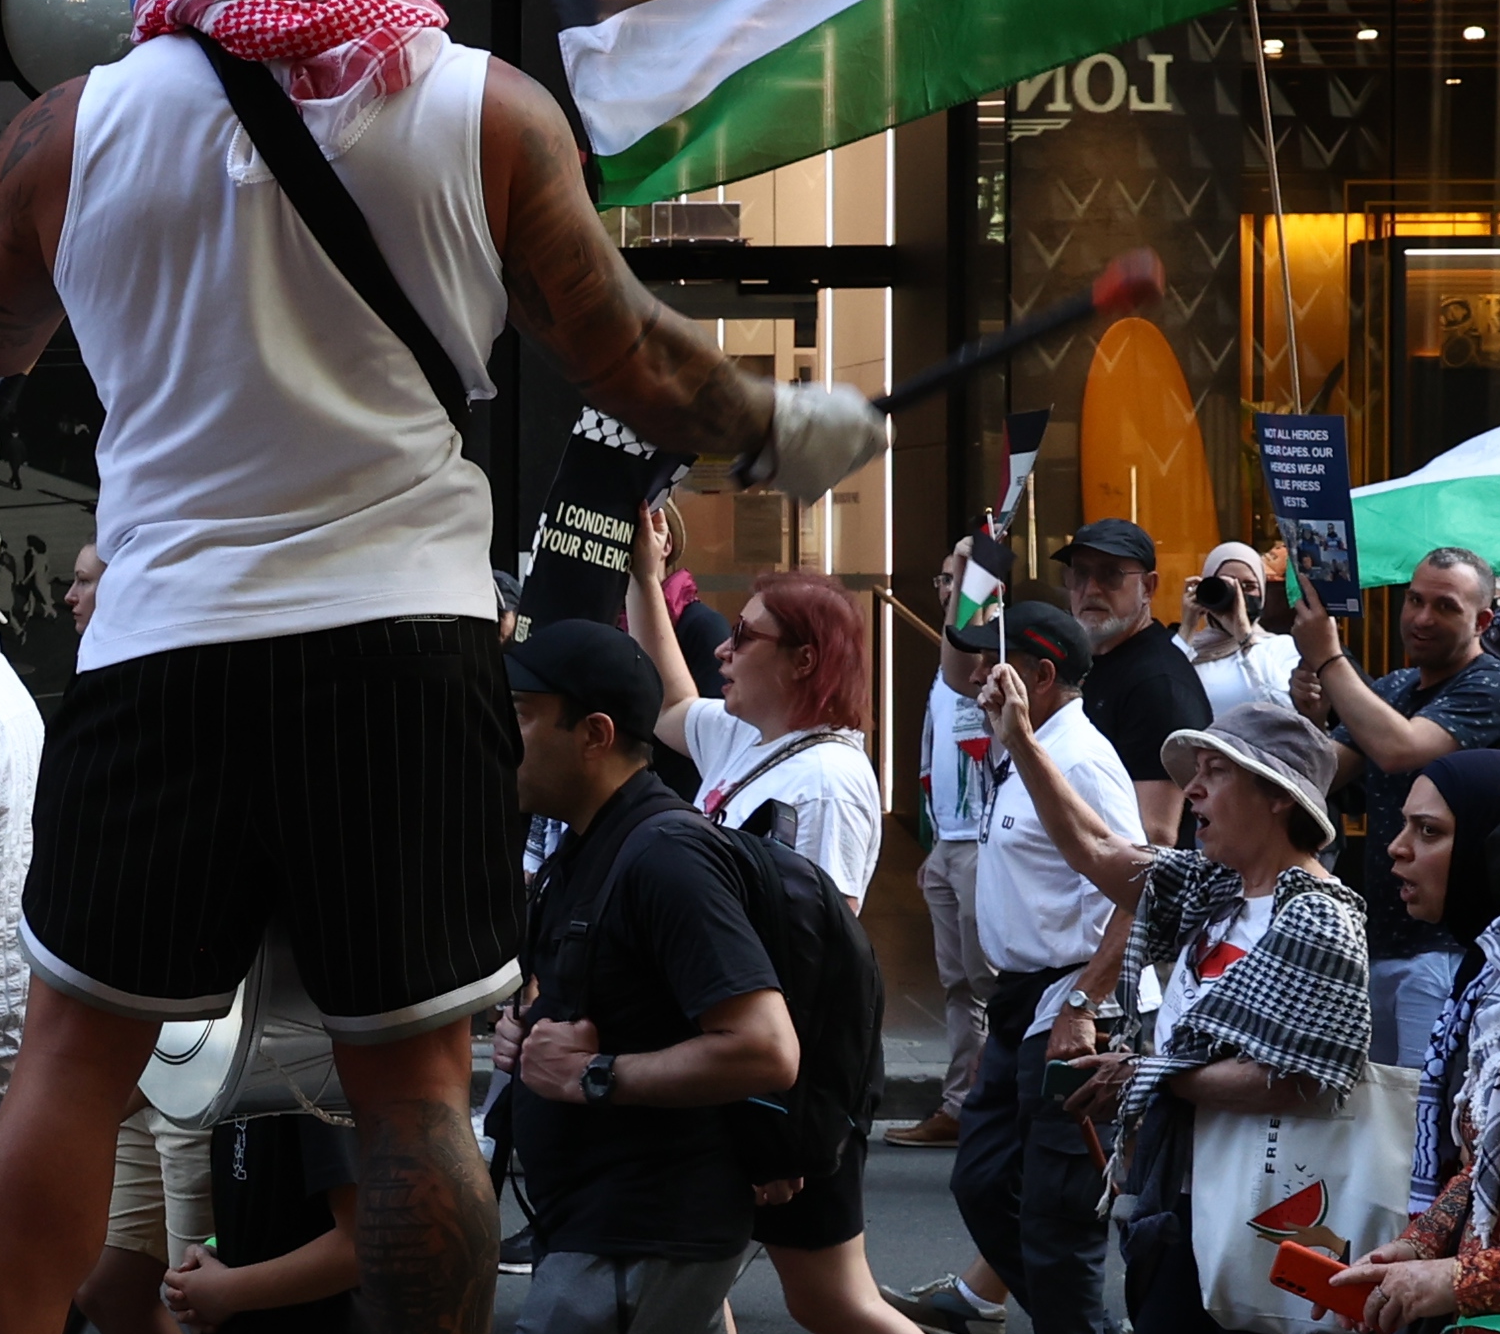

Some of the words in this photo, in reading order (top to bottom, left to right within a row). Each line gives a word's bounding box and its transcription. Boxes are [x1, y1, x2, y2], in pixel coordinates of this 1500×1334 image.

[1264, 427, 1277, 440] NOT
[1277, 428, 1292, 441] ALL
[1291, 429, 1330, 442] HEROES
[1311, 446, 1334, 459] OUR
[1269, 461, 1297, 474] HEROES
[1297, 462, 1326, 476] WEAR
[1274, 477, 1292, 491] BLUE
[1291, 478, 1321, 492] PRESS
[555, 500, 566, 524] I
[564, 503, 636, 546] CONDEMN
[541, 525, 582, 560] YOUR
[581, 538, 632, 574] SILENC
[1265, 1118, 1281, 1174] FREE
